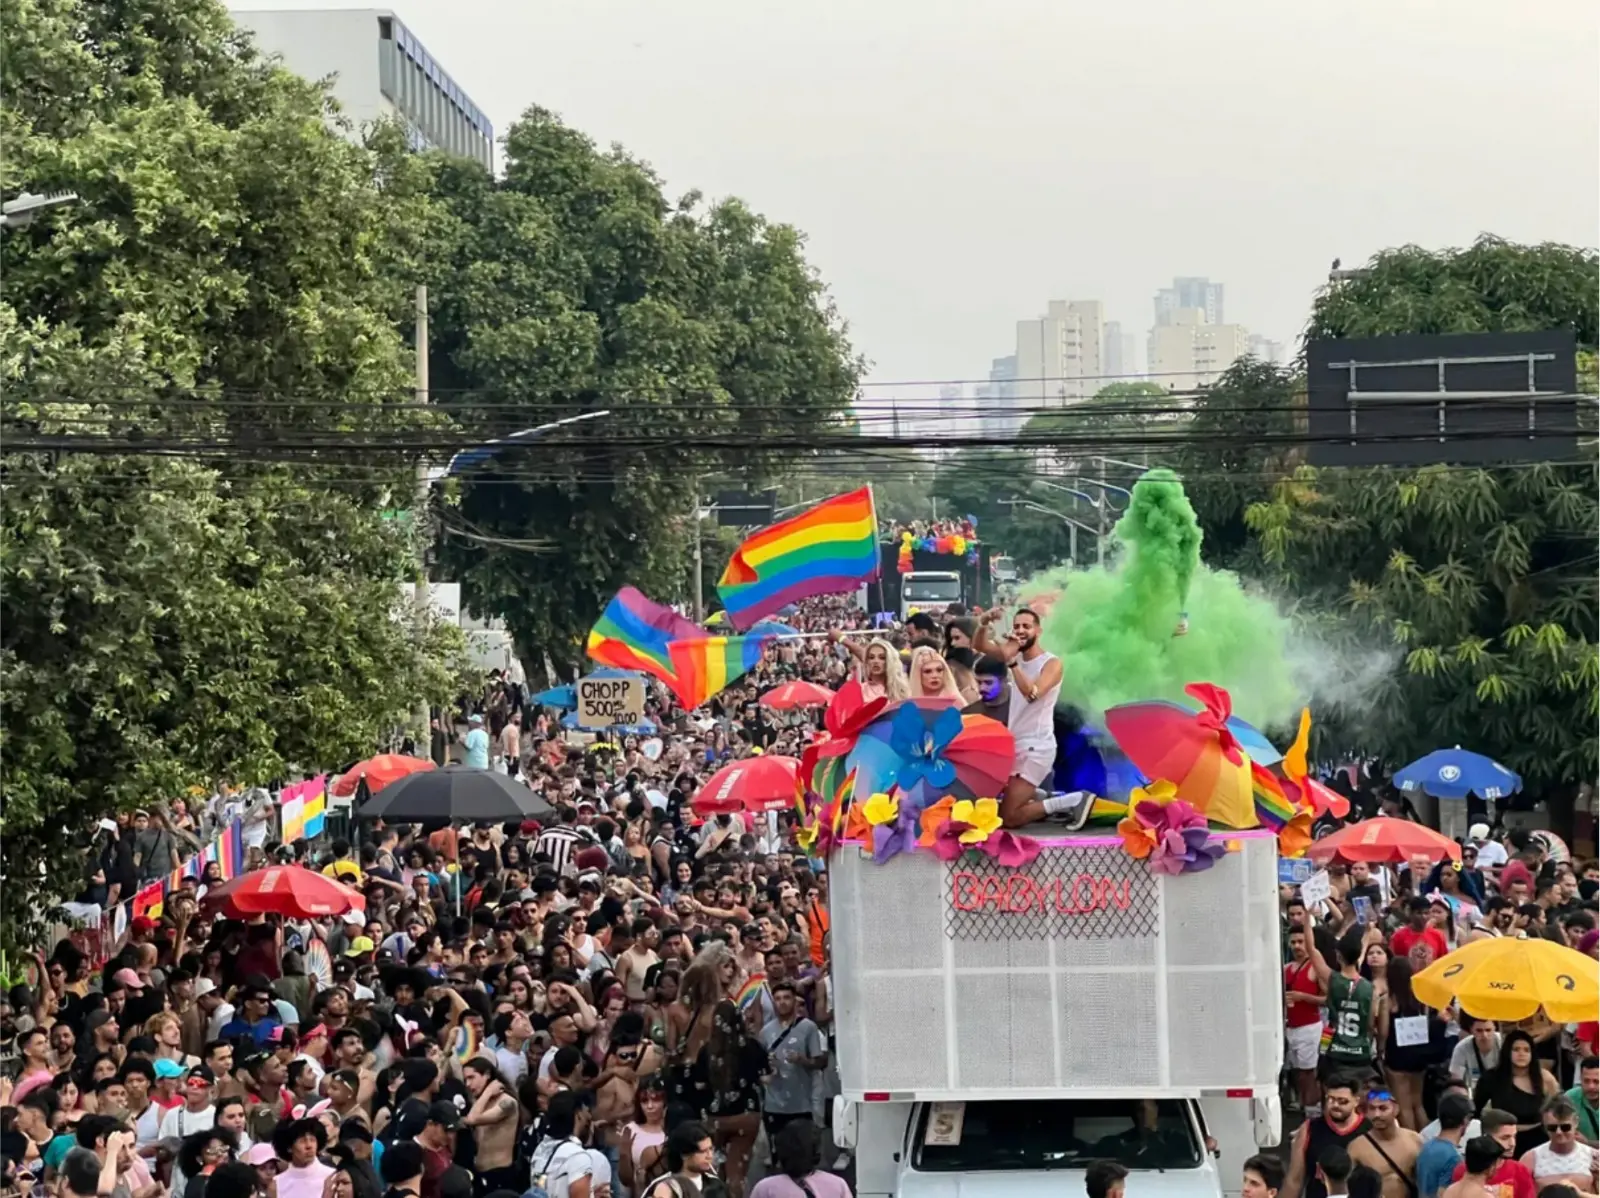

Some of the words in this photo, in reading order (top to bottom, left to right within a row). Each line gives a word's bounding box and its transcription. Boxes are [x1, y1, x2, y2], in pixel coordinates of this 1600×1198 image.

[581, 680, 630, 699] CHOPP
[953, 871, 1132, 914] BABYLON
[1338, 1011, 1361, 1038] 16
